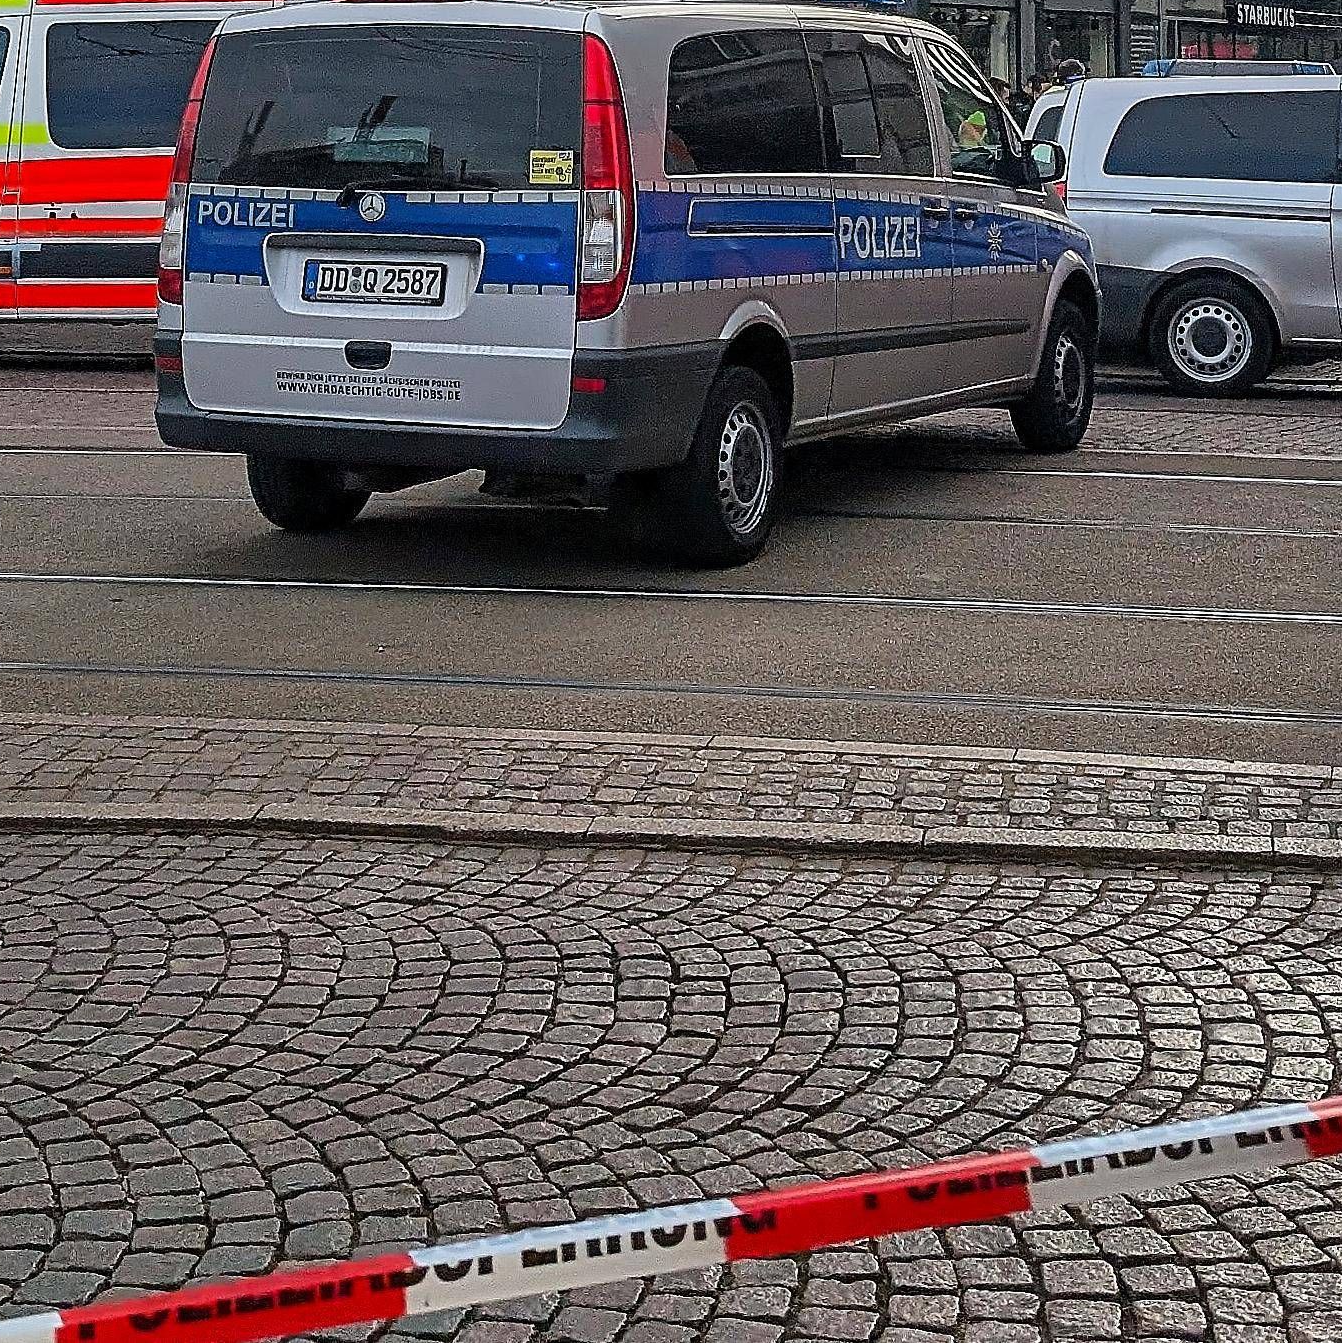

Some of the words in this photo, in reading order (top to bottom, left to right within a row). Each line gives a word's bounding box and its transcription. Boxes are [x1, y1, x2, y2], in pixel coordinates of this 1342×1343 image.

[1236, 3, 1296, 28] STARBUCKS
[197, 200, 296, 228] POLIZEI
[839, 215, 922, 259] POLIZEI
[319, 266, 349, 292] DD
[363, 268, 378, 293] Q
[382, 268, 440, 295] 2587
[276, 381, 462, 402] WWW.VERDAECHTIG-GUTE-JOBS.DE
